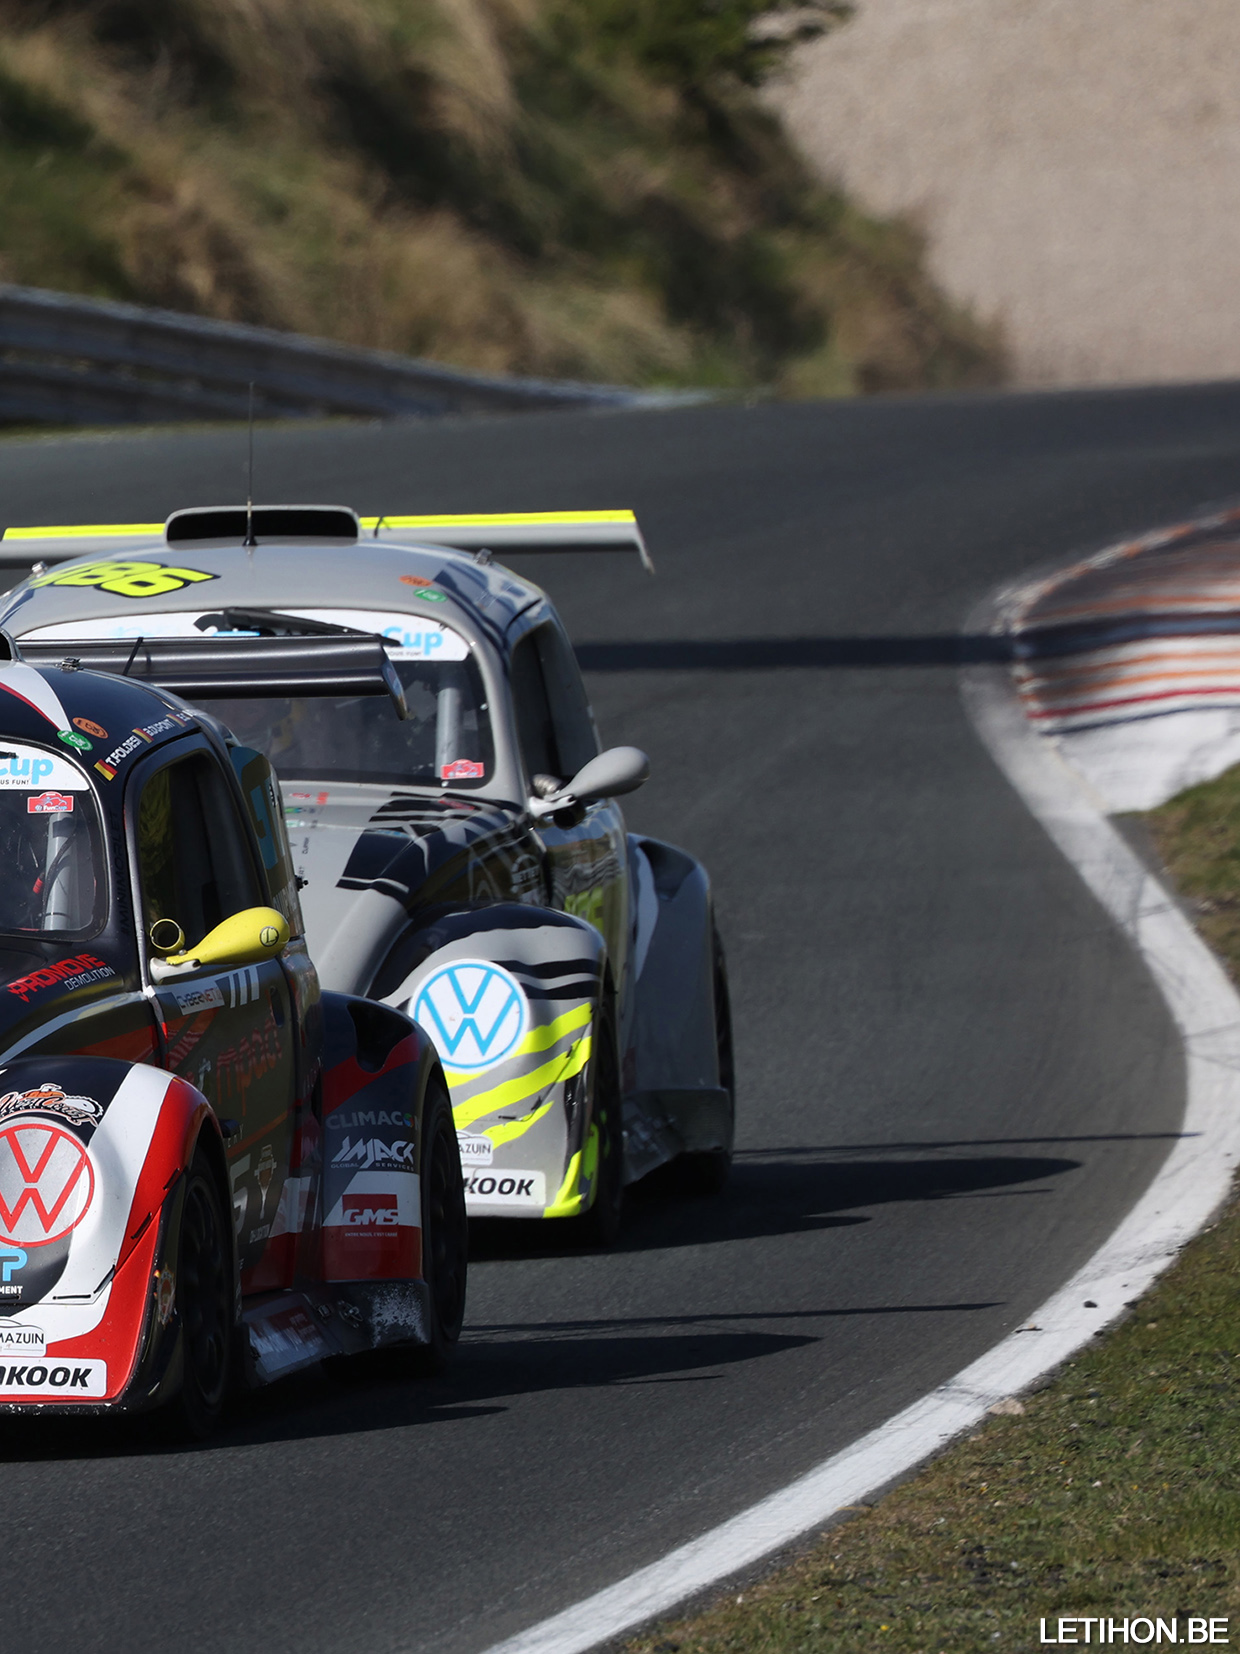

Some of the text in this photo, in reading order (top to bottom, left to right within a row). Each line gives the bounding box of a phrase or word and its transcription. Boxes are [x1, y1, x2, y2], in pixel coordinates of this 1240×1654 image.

[64, 966, 115, 991] DEMOLITION
[459, 1143, 491, 1155] AZUIN
[376, 1162, 415, 1171] SERVICES
[462, 1177, 534, 1196] KOOK
[343, 1208, 398, 1226] GMS
